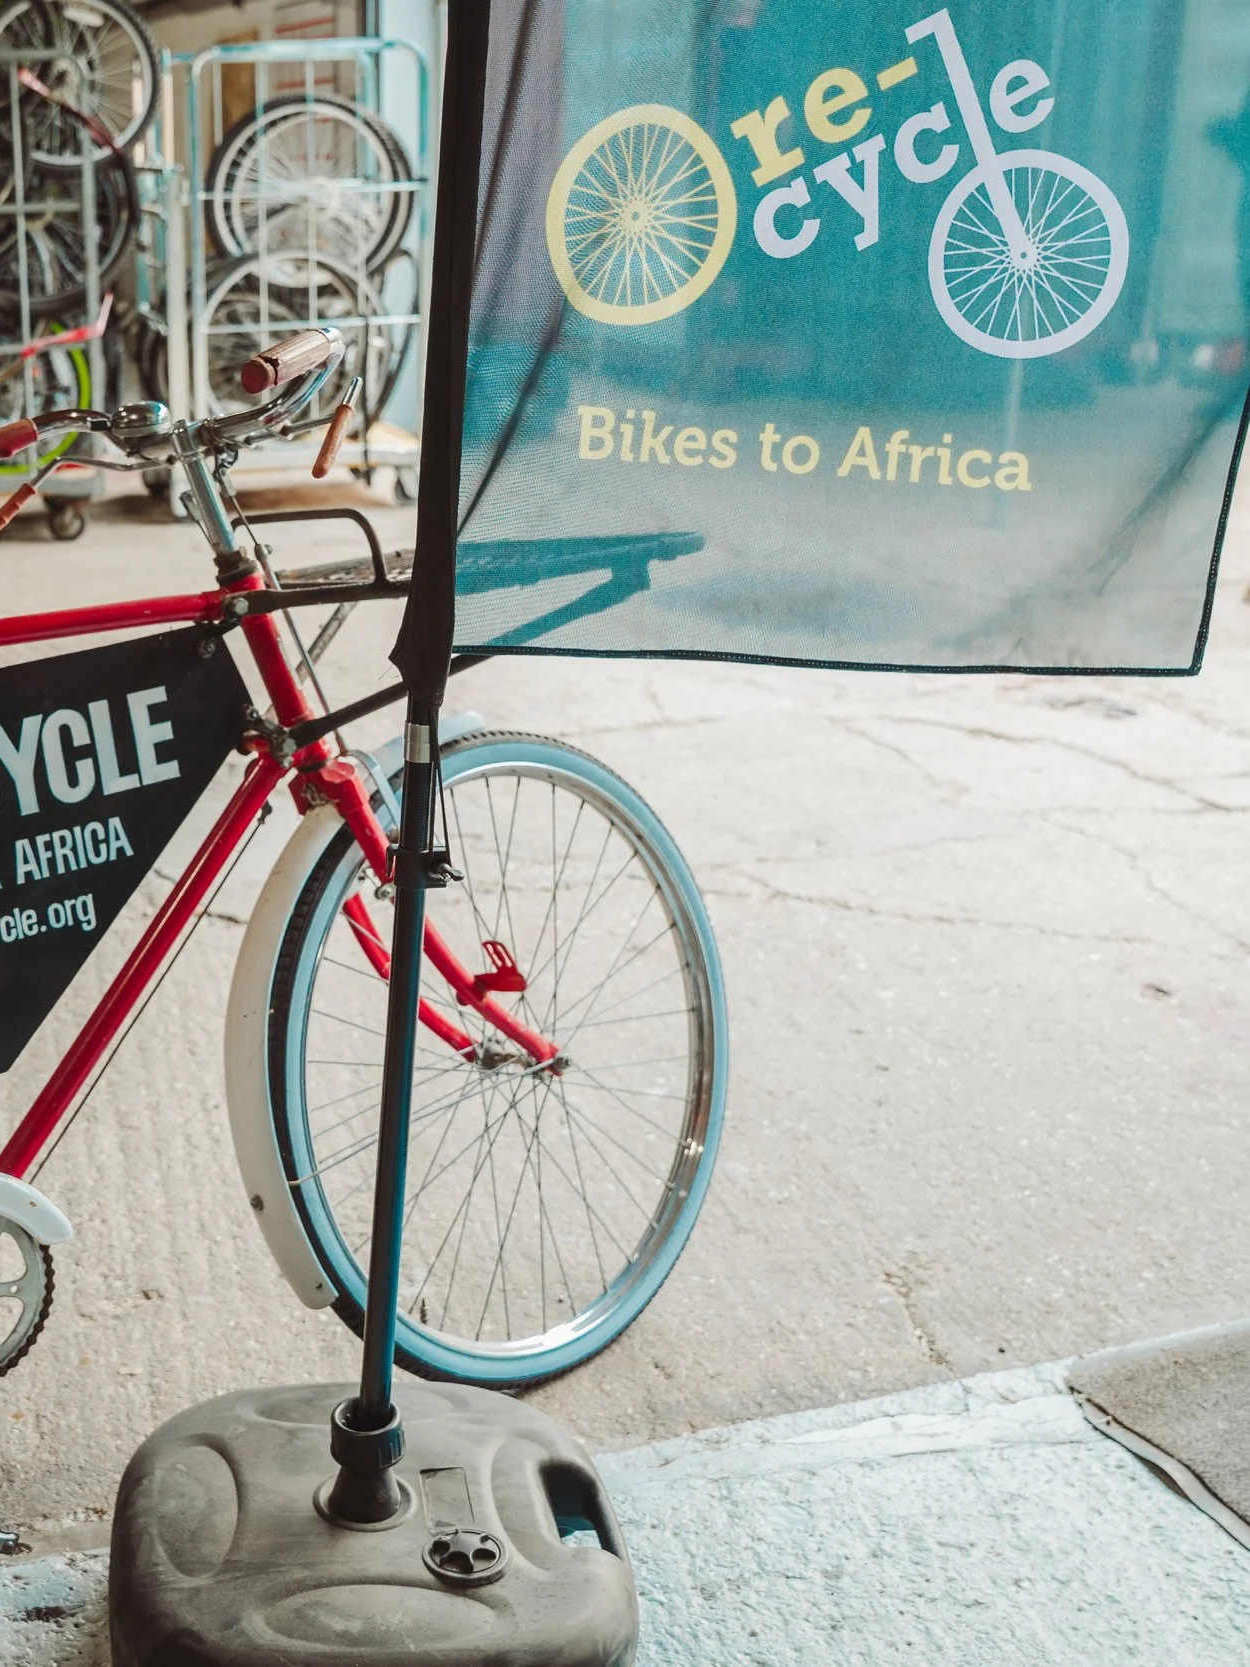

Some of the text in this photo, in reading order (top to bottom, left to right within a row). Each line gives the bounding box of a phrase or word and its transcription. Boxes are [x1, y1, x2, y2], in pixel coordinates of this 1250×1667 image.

[730, 56, 918, 187] re-
[753, 8, 1054, 259] cycle
[577, 405, 1032, 491] Bikes to Africa
[15, 816, 134, 885] AFRICA
